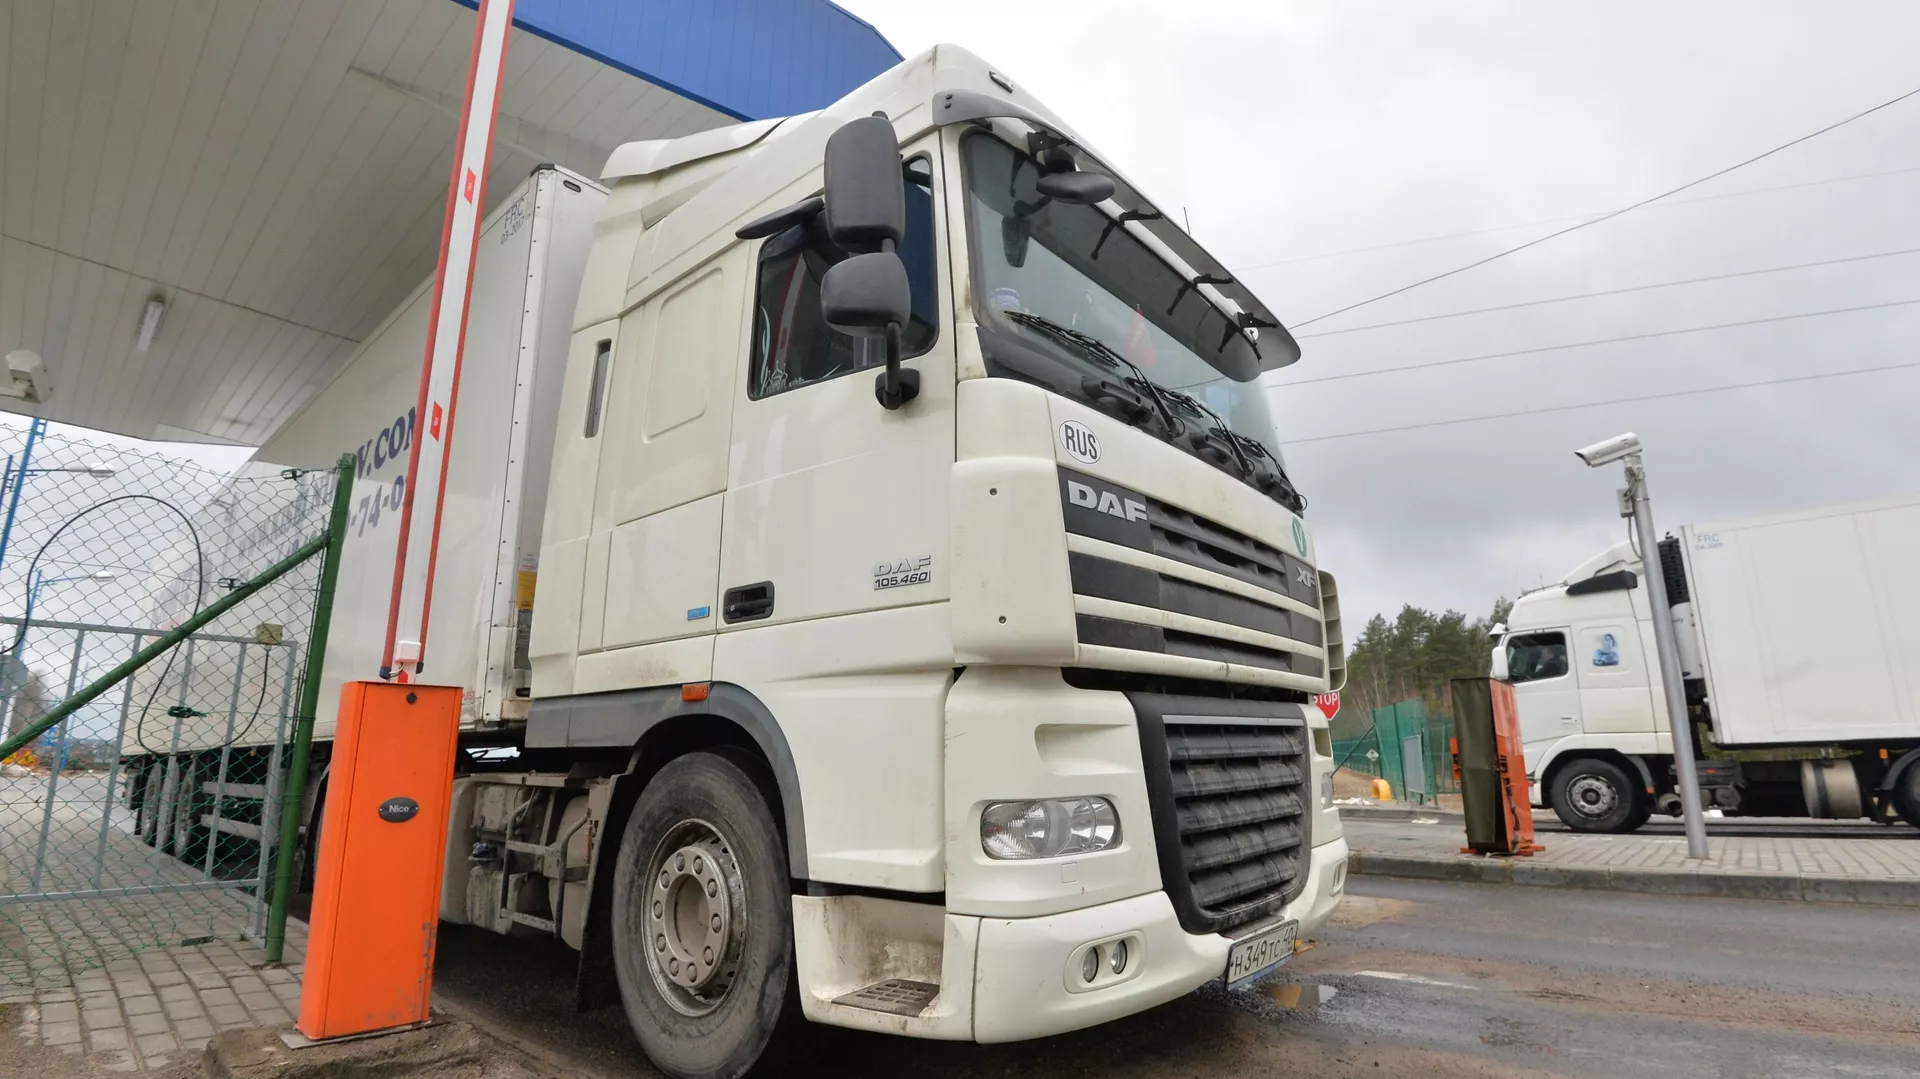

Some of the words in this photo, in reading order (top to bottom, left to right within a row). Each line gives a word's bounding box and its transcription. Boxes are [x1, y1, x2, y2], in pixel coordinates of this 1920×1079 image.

[1063, 423, 1099, 460] RUS
[1067, 479, 1148, 523] DAF
[873, 554, 931, 578] DAF
[1295, 565, 1316, 589] XF
[874, 571, 929, 589] 105.460
